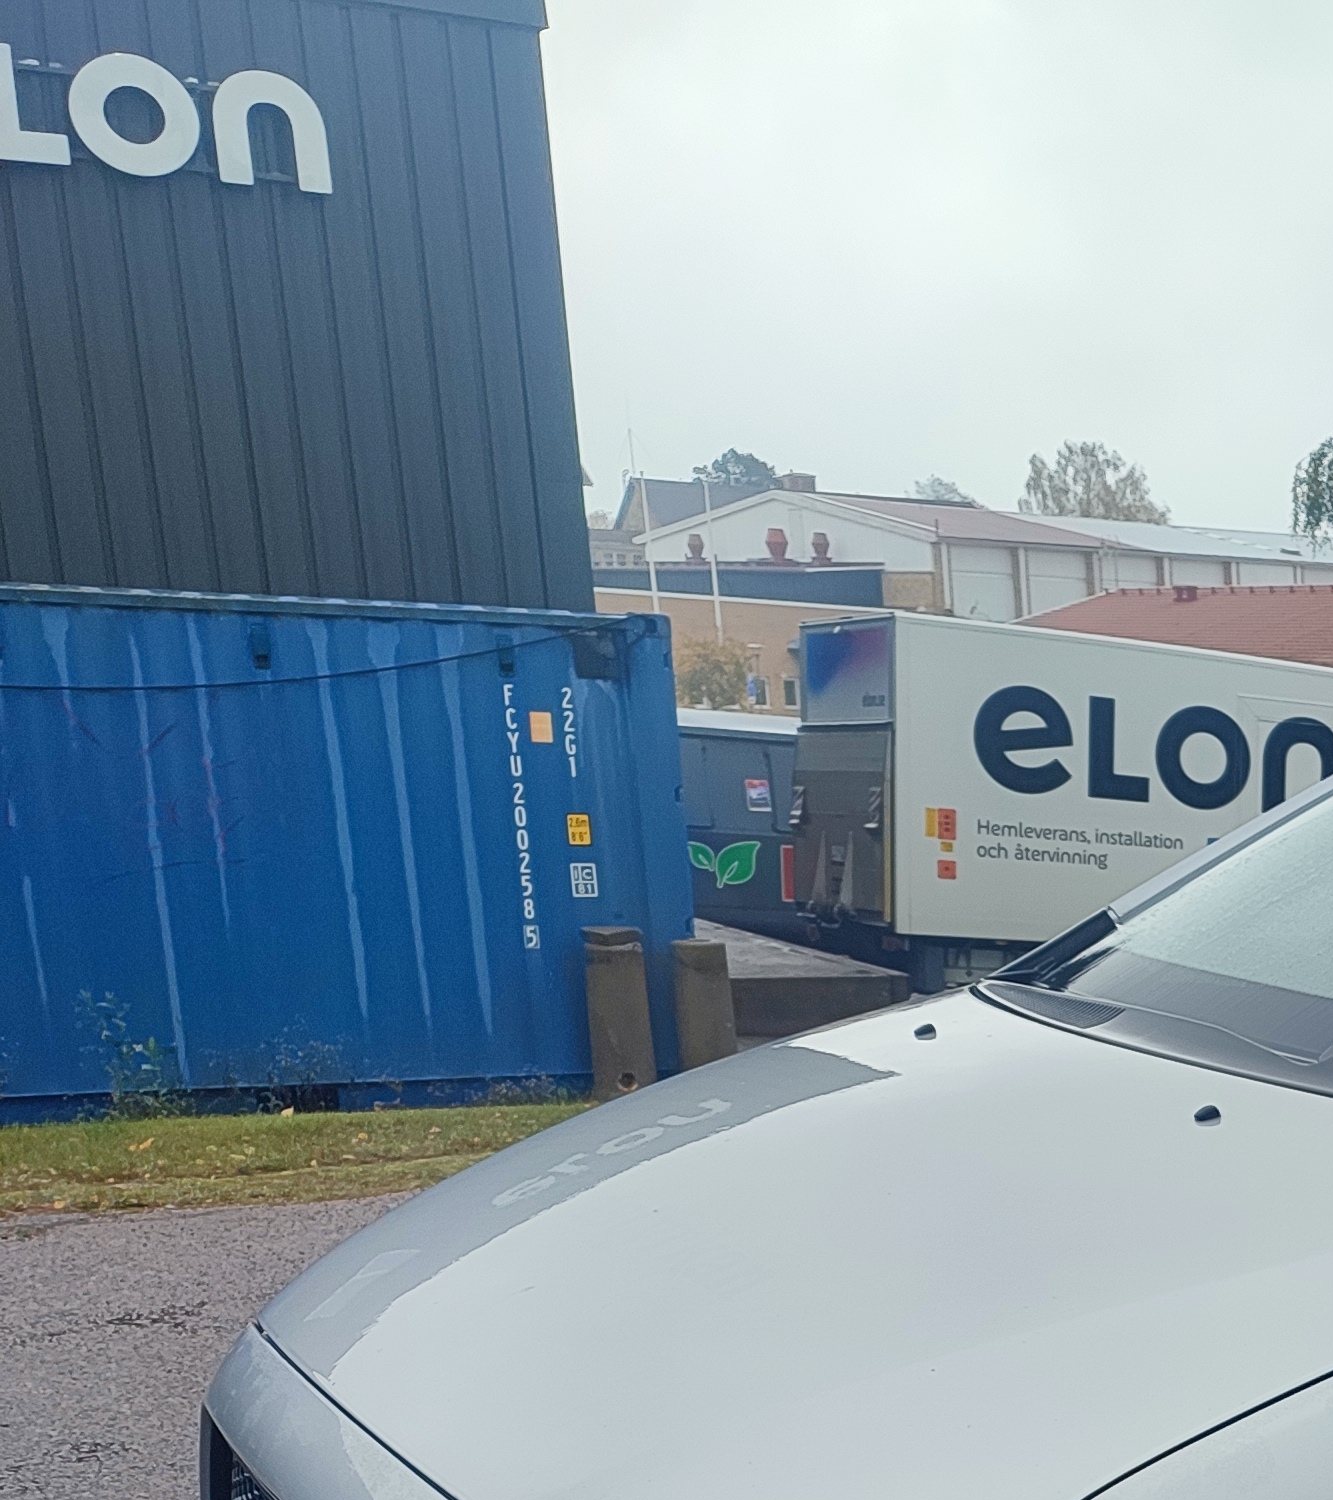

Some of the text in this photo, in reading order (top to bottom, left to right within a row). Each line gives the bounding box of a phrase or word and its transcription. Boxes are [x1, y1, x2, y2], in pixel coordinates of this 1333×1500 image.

[977, 819, 1184, 850] Hemleverans, installation
[976, 843, 1109, 870] och återvinning
